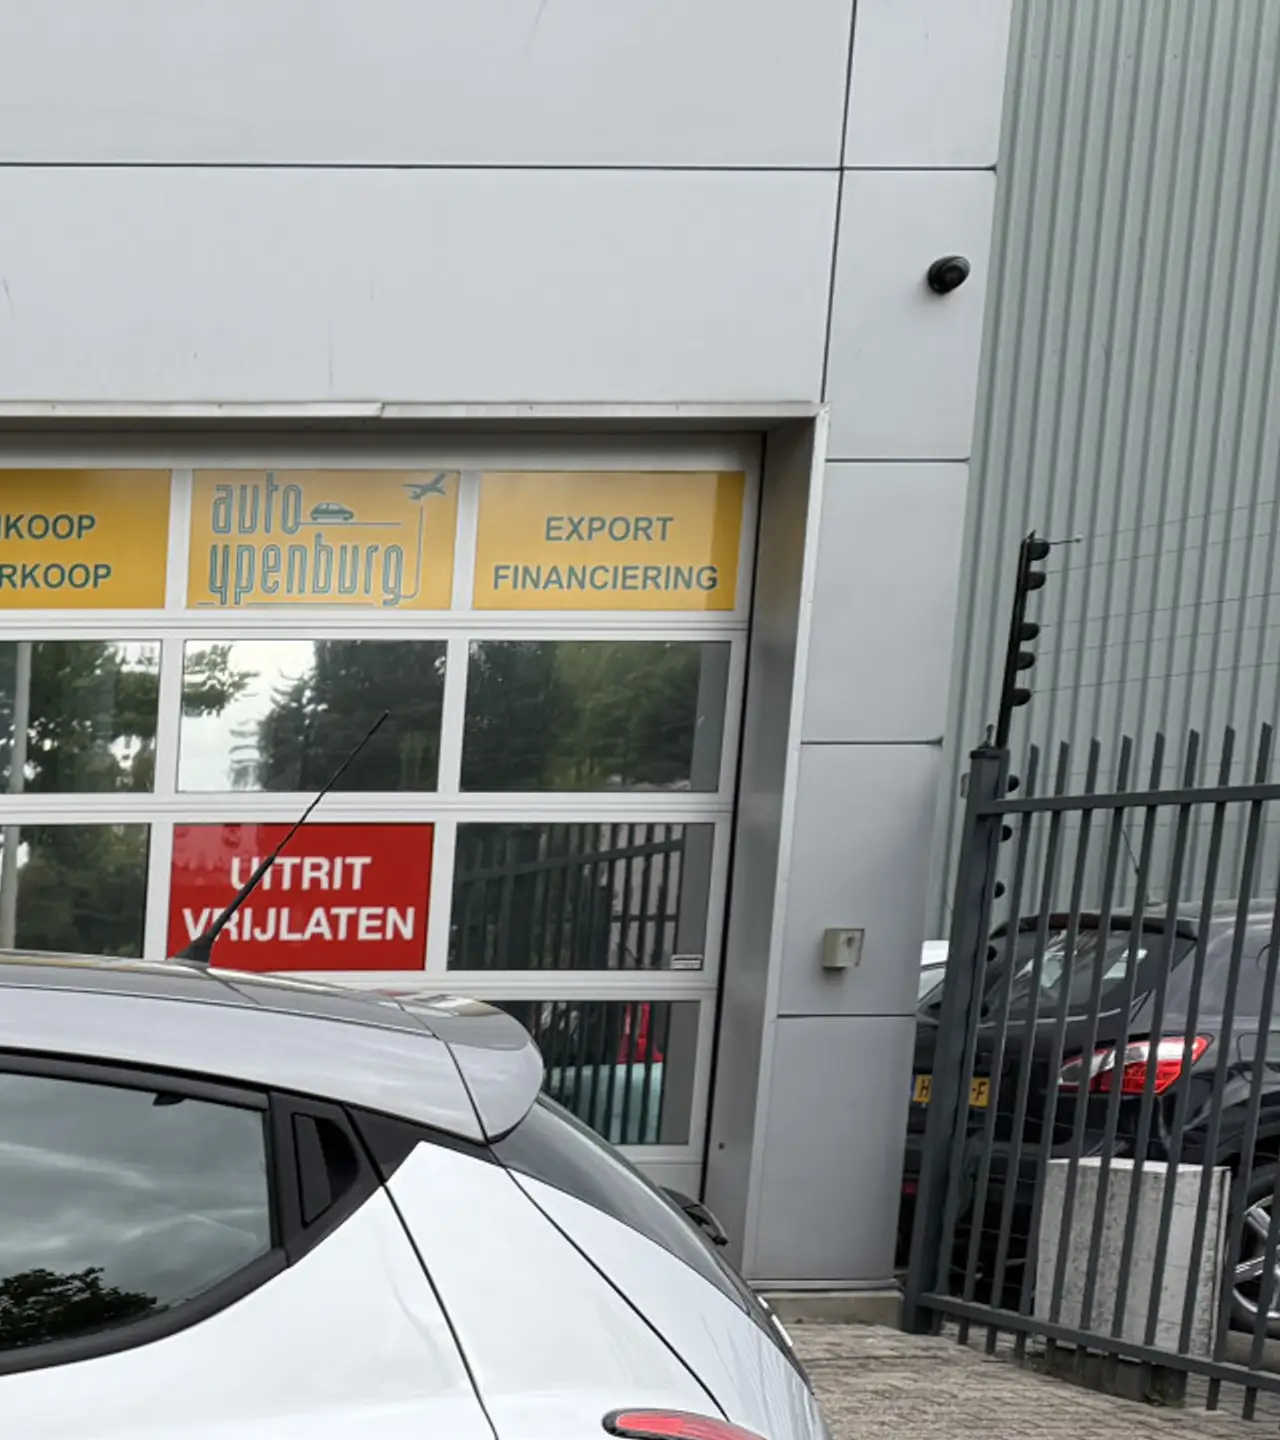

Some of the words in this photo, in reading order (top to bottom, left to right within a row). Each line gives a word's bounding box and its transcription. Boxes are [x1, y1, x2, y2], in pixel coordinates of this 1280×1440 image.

[210, 470, 302, 536] auto
[544, 515, 675, 543] EXPORT
[207, 532, 404, 606] ypenburg
[492, 563, 720, 592] FINANCIERING
[230, 855, 373, 892] UITRIT
[181, 905, 416, 943] VRIJLATEN
